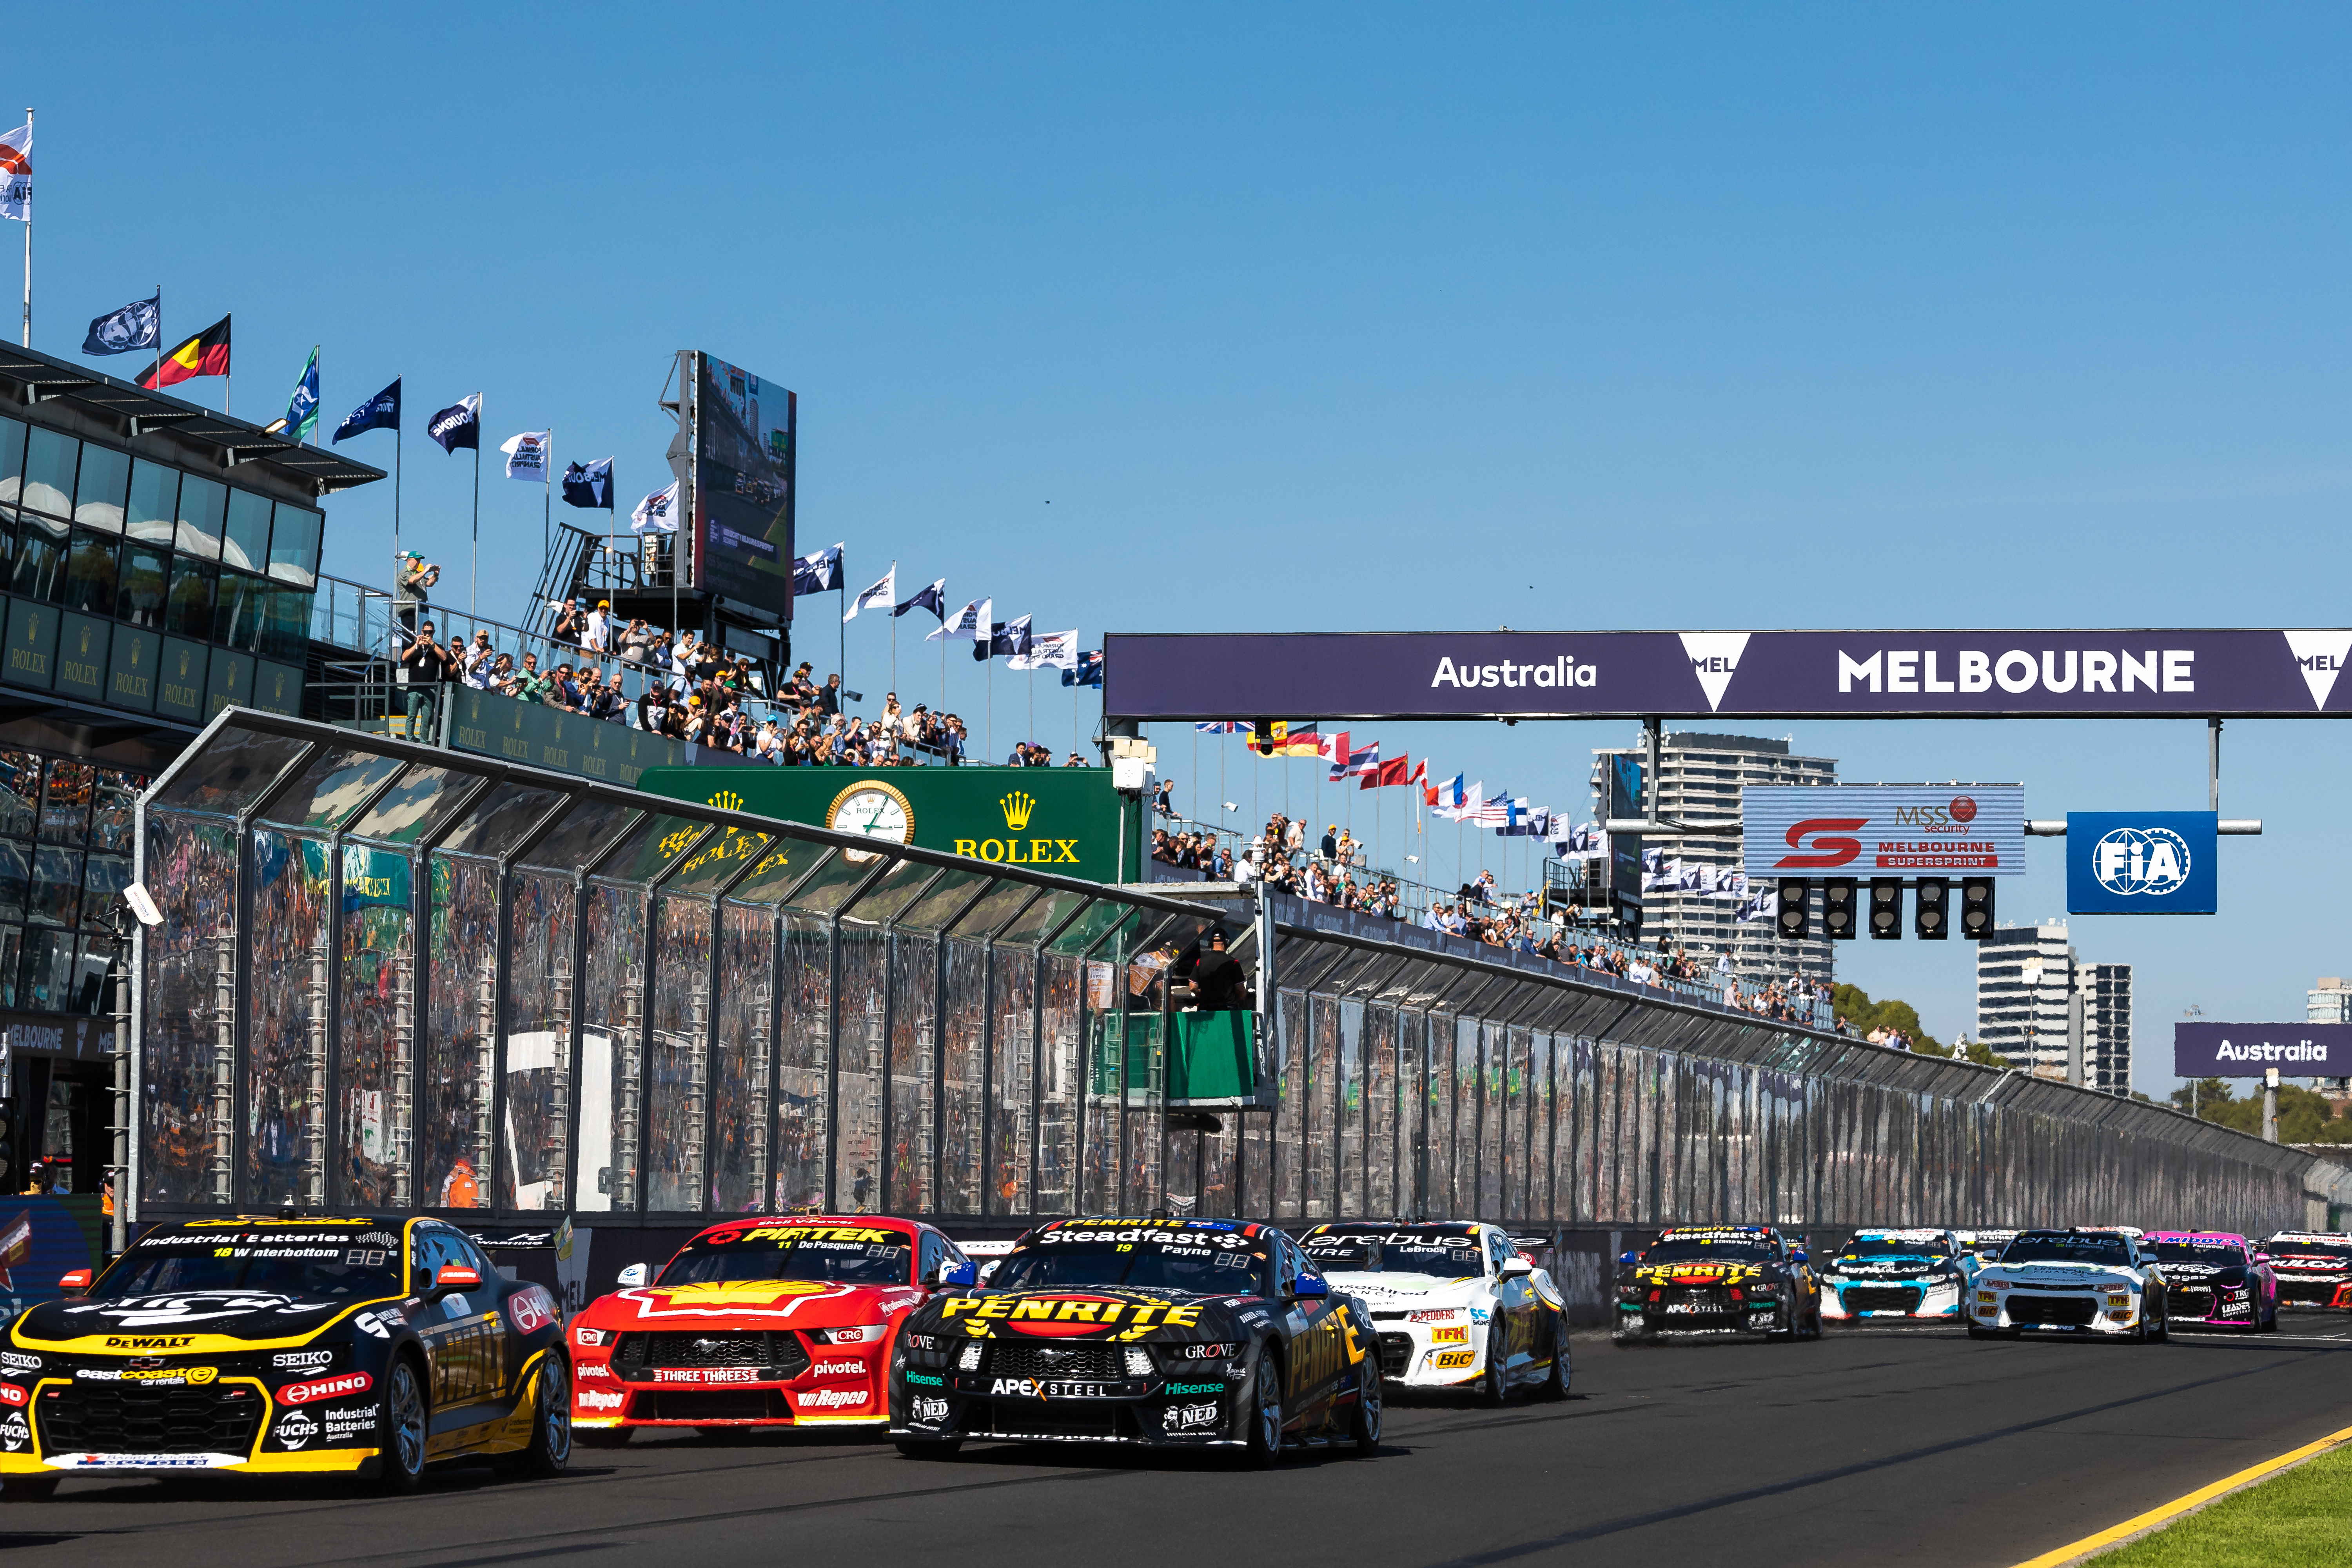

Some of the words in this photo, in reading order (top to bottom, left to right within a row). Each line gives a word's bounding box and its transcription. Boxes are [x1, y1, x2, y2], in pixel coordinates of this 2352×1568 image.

[11, 648, 45, 675] ROLEX
[1692, 657, 1735, 673] MEL
[2297, 655, 2340, 671] MEL
[64, 661, 98, 686] ROLEX
[1431, 655, 1596, 688] Australia
[1839, 650, 2195, 693] MELBOURNE
[116, 673, 148, 697] ROLEX
[164, 683, 196, 708] ROLEX
[458, 726, 486, 749] ROLEX
[503, 737, 529, 759] ROLEX
[544, 746, 568, 768] ROLEX
[582, 755, 606, 776] ROLEX
[1895, 806, 1949, 826] MSS
[1924, 824, 1970, 835] security
[955, 839, 1080, 863] ROLEX
[1878, 842, 1995, 852] MELBOURNE
[1888, 857, 1987, 866] SUPERSPRINT
[6, 1024, 63, 1050] MELBOURNE
[2216, 1040, 2328, 1062] Australia
[140, 1234, 238, 1246] Industrial
[742, 1227, 894, 1243] PIRTEK
[1040, 1229, 1209, 1245] Steadfast
[1308, 1232, 1472, 1247] erebus
[1663, 1231, 1747, 1242] Steadfast
[2165, 1237, 2241, 1246] MIDDY'S
[214, 1248, 233, 1257] 18
[234, 1248, 339, 1258] Wnterbottom
[1116, 1244, 1133, 1252] 19
[1161, 1245, 1211, 1256] Payne
[1400, 1246, 1447, 1254] LeBrocq
[1635, 1266, 1763, 1278] PENRITE
[1328, 1284, 1429, 1296] nsecured
[1334, 1289, 1396, 1298] NANCE
[2110, 1296, 2127, 1304] TFH
[2222, 1302, 2250, 1313] LEADER
[942, 1298, 1203, 1327] PENRITE
[1421, 1309, 1454, 1321] PEDDERS
[1470, 1308, 1489, 1319] SS
[1979, 1307, 1997, 1315] BIC
[582, 1333, 597, 1342] CRC
[838, 1330, 862, 1339] CRC
[1434, 1327, 1464, 1340] TFH
[907, 1333, 933, 1350] ROVE
[273, 1351, 332, 1366] SEIKO
[1185, 1343, 1235, 1359] GROVE
[1, 1352, 42, 1368] SEIKO
[1438, 1353, 1473, 1366] BIC
[76, 1368, 187, 1379] eastcoast
[663, 1370, 701, 1382] THREE
[702, 1370, 750, 1381] THREES
[813, 1360, 866, 1378] pivotel.
[156, 1377, 185, 1385] rentals
[311, 1376, 365, 1396] HINO
[906, 1371, 943, 1386] Hisense
[0, 1388, 21, 1401] NO
[1049, 1384, 1107, 1396] STEEL
[1165, 1383, 1224, 1395] Hisense
[815, 1389, 868, 1409] Repco
[325, 1405, 376, 1420] Industrial
[923, 1402, 948, 1417] NED
[1182, 1406, 1217, 1424] NED
[272, 1423, 318, 1437] FUCHS
[325, 1419, 375, 1432] Batteries
